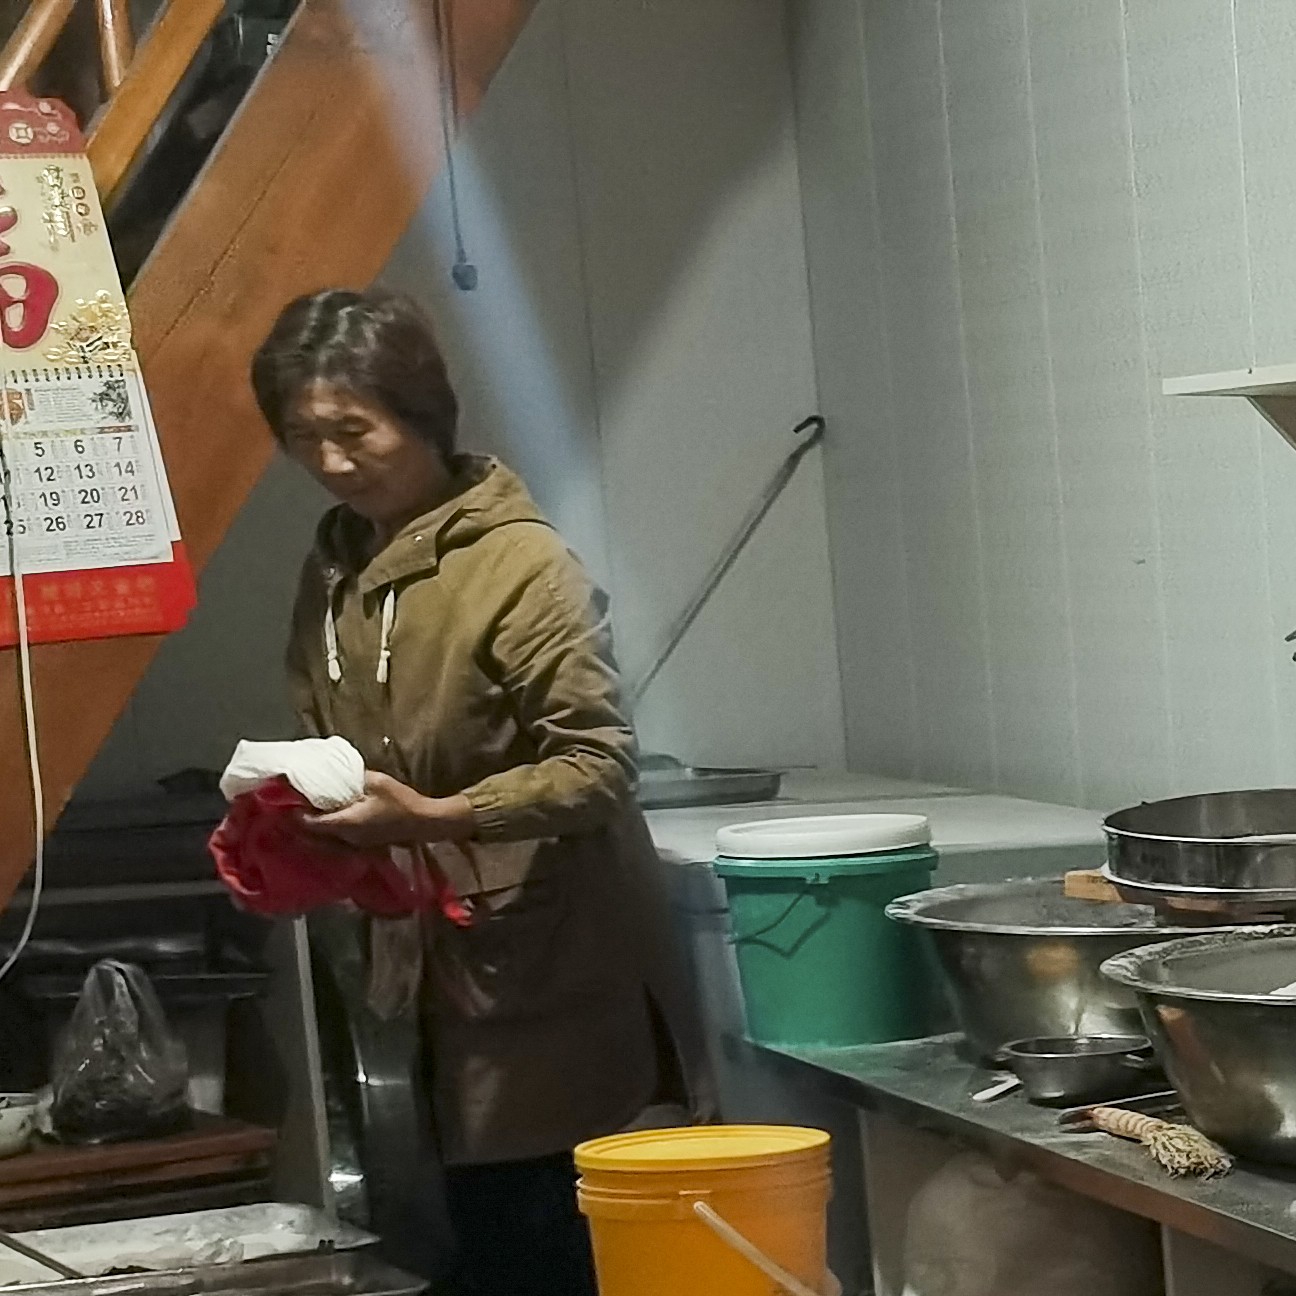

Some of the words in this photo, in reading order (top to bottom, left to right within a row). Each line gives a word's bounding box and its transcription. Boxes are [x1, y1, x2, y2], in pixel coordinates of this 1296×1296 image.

[34, 442, 45, 457] 5
[74, 439, 85, 454] 6
[113, 437, 123, 452] 7
[34, 467, 56, 482] 12
[74, 463, 96, 479] 13
[114, 460, 136, 477] 14
[39, 491, 61, 507] 19
[78, 488, 101, 504] 20
[118, 485, 139, 502] 21
[44, 516, 67, 532] 26
[84, 513, 104, 529] 27
[123, 510, 146, 526] 28
